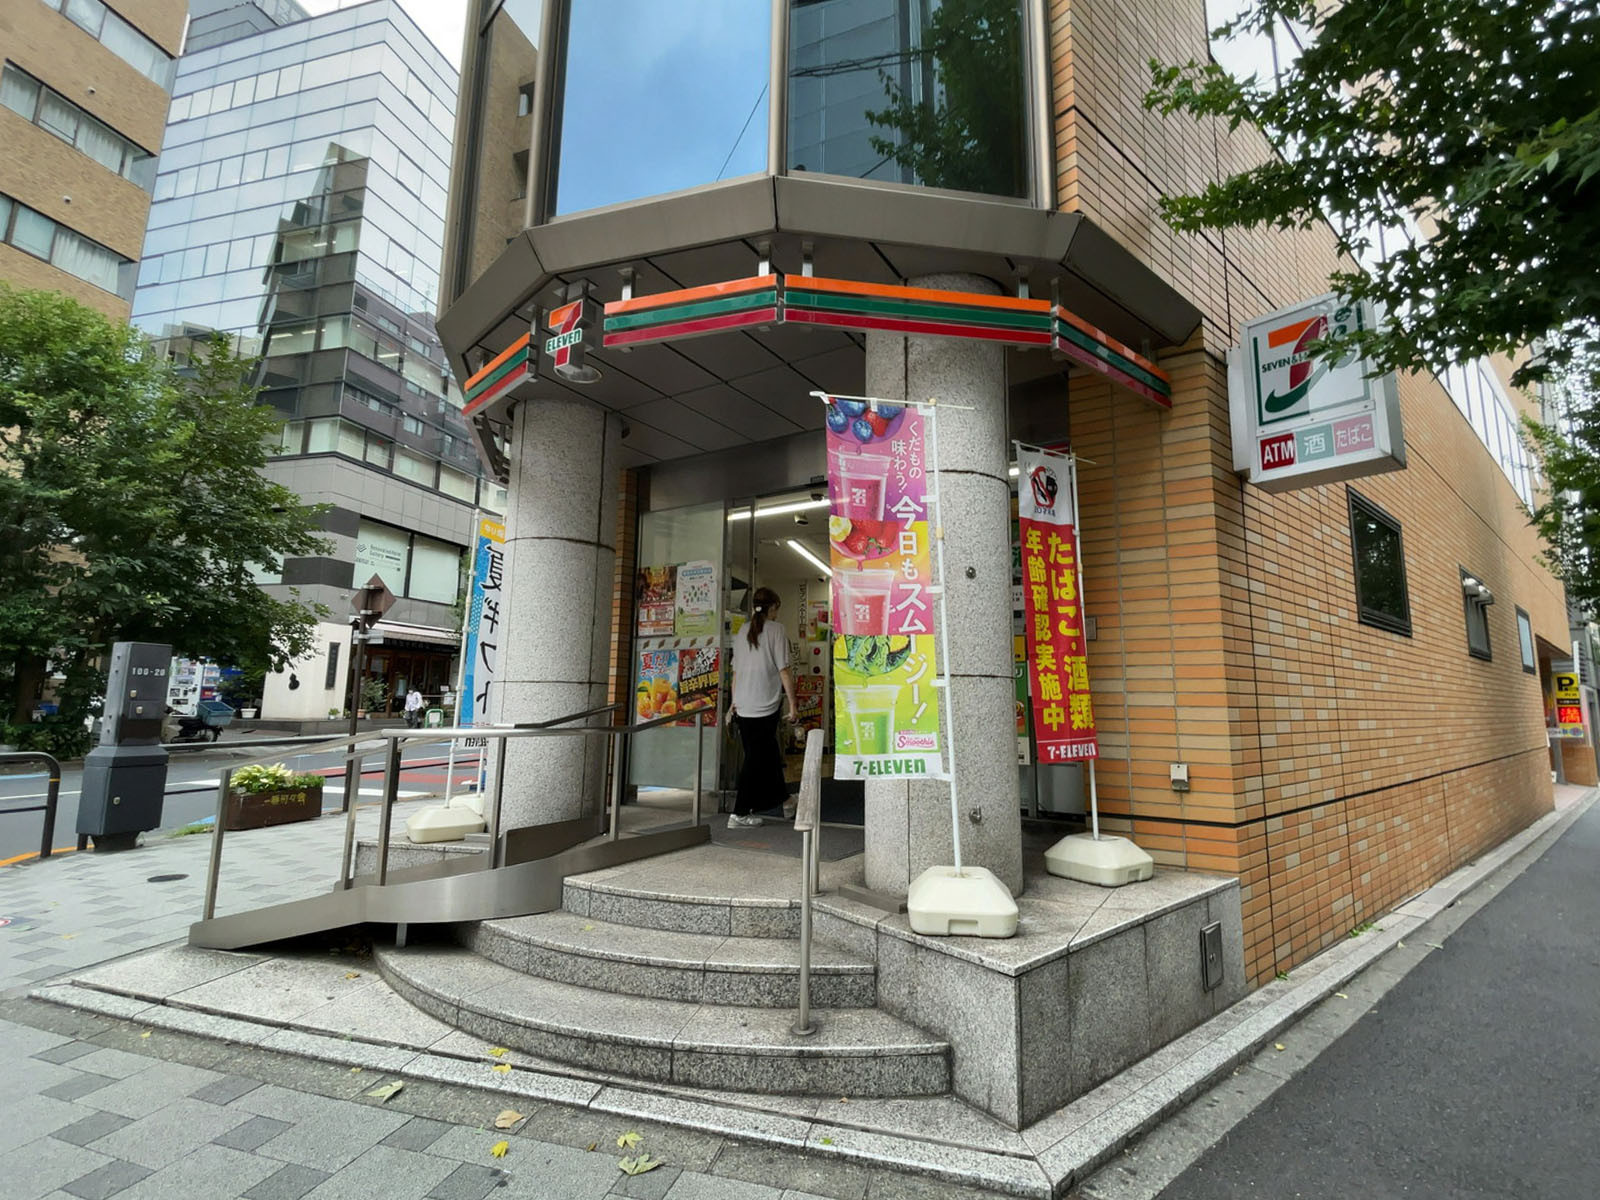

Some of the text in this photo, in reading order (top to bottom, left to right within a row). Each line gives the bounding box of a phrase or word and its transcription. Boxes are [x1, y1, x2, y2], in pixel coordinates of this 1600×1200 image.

[1304, 432, 1326, 456] 酒
[1336, 423, 1373, 449] たばこ
[909, 421, 922, 479] くだもの
[1264, 440, 1295, 465] ATM
[1026, 527, 1065, 732] 年齢確認実施中
